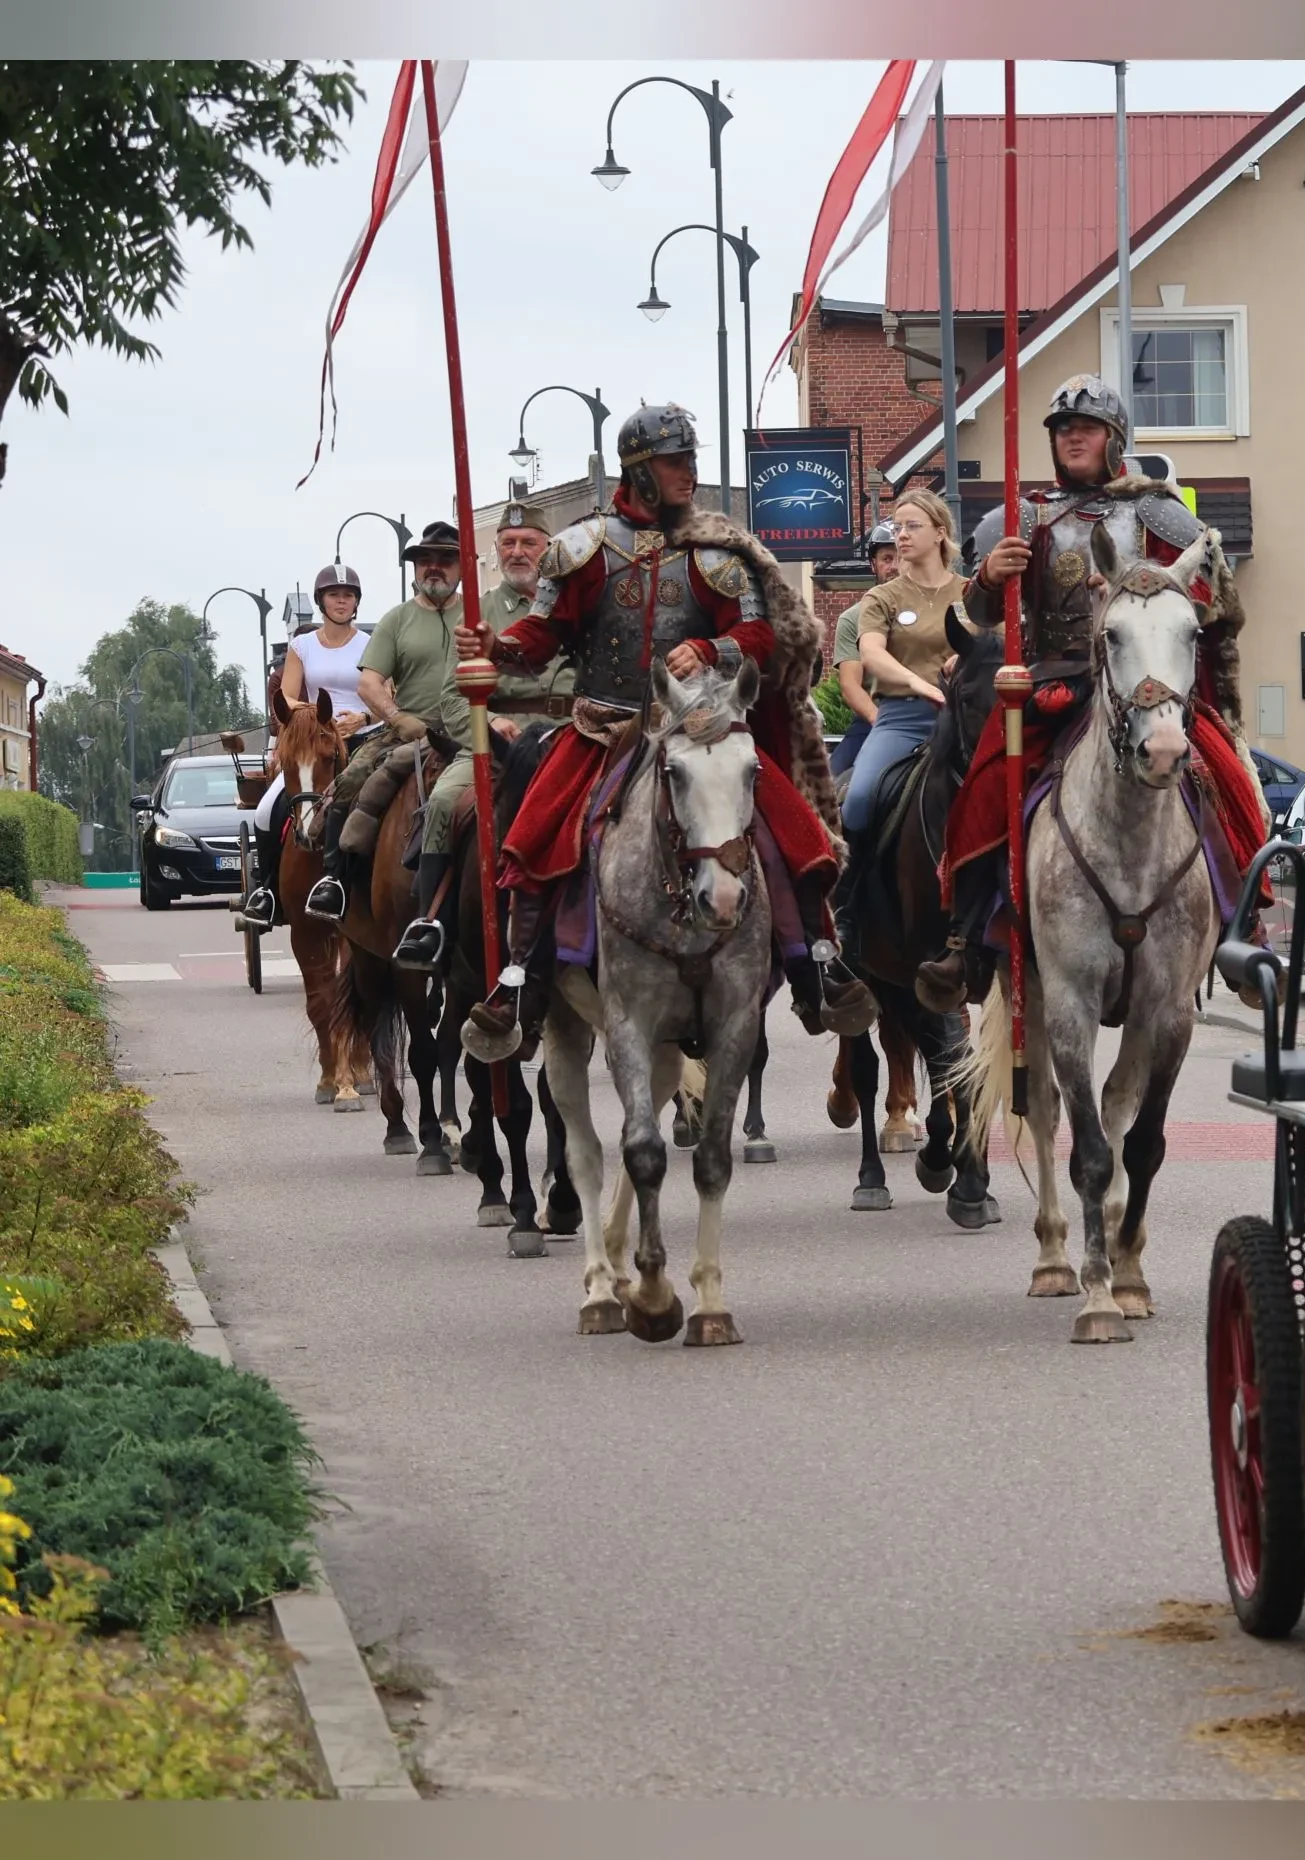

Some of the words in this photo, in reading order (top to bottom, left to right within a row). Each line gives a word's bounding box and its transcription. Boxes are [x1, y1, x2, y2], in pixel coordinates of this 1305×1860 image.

[752, 460, 788, 492] AUTO
[796, 460, 845, 489] SERWIS
[757, 528, 844, 540] TREIDER
